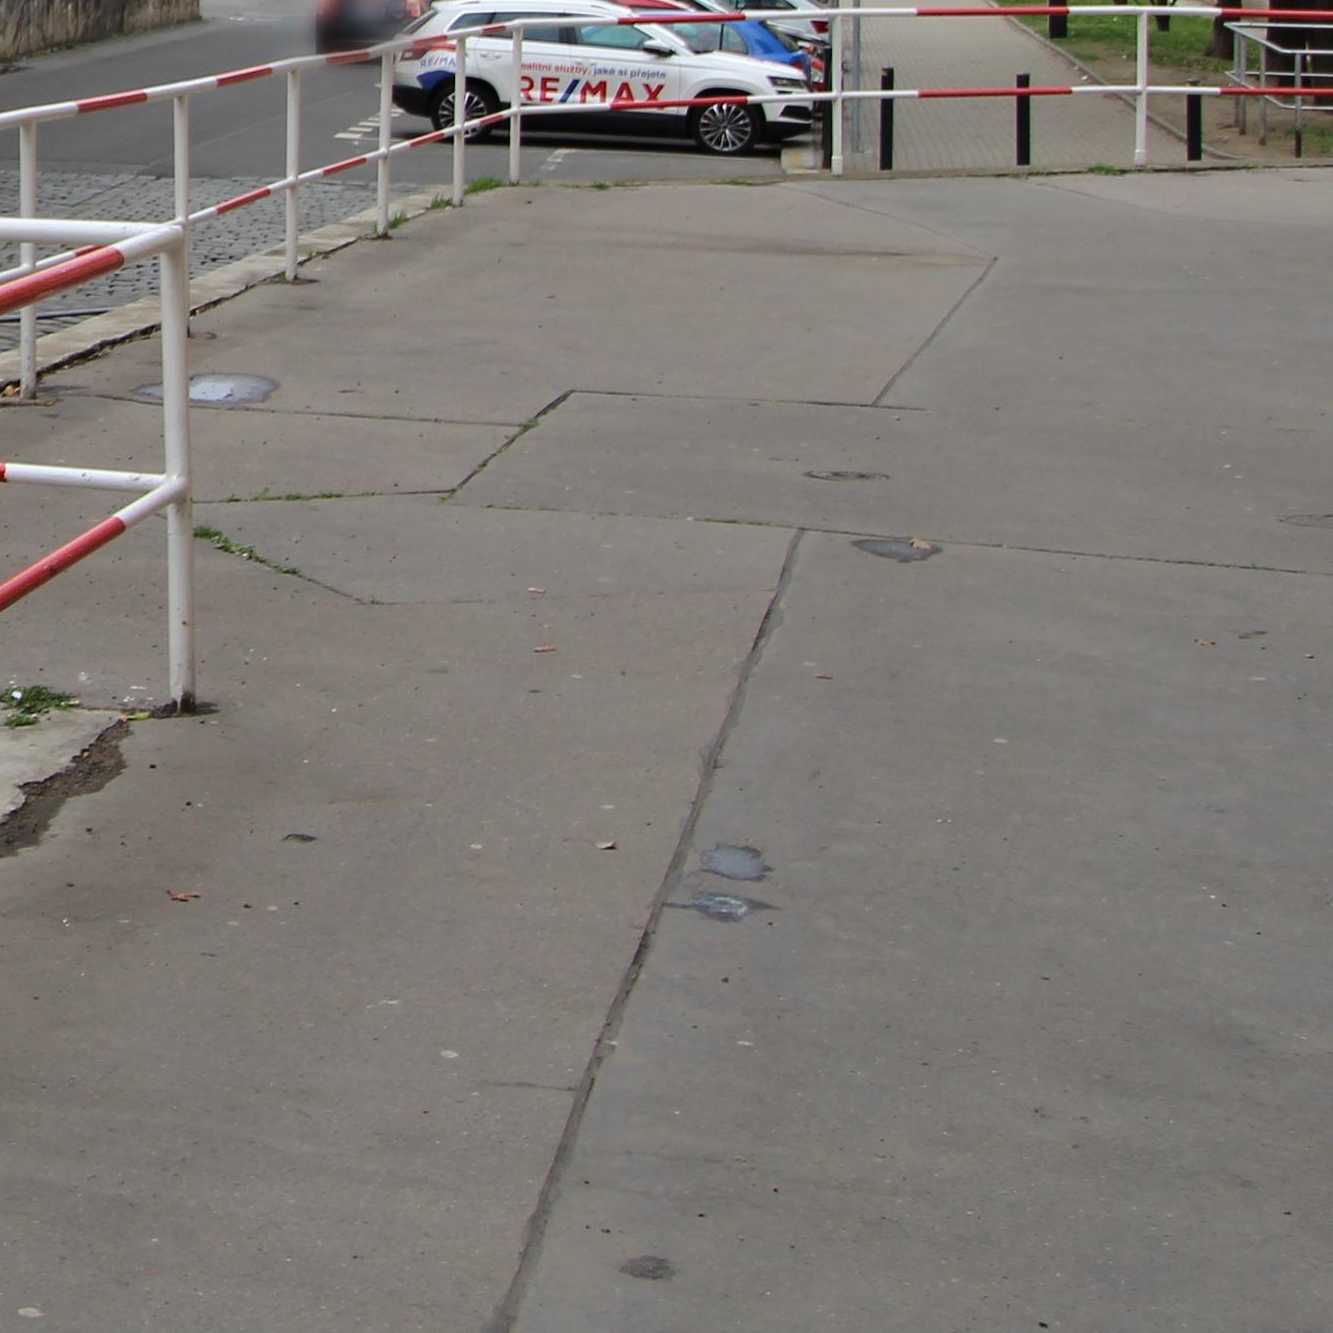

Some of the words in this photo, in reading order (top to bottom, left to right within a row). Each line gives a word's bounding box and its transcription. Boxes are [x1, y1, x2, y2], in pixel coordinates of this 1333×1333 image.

[420, 56, 456, 68] RE/MA
[520, 63, 552, 71] ealitní
[520, 75, 665, 104] RE/MAX
